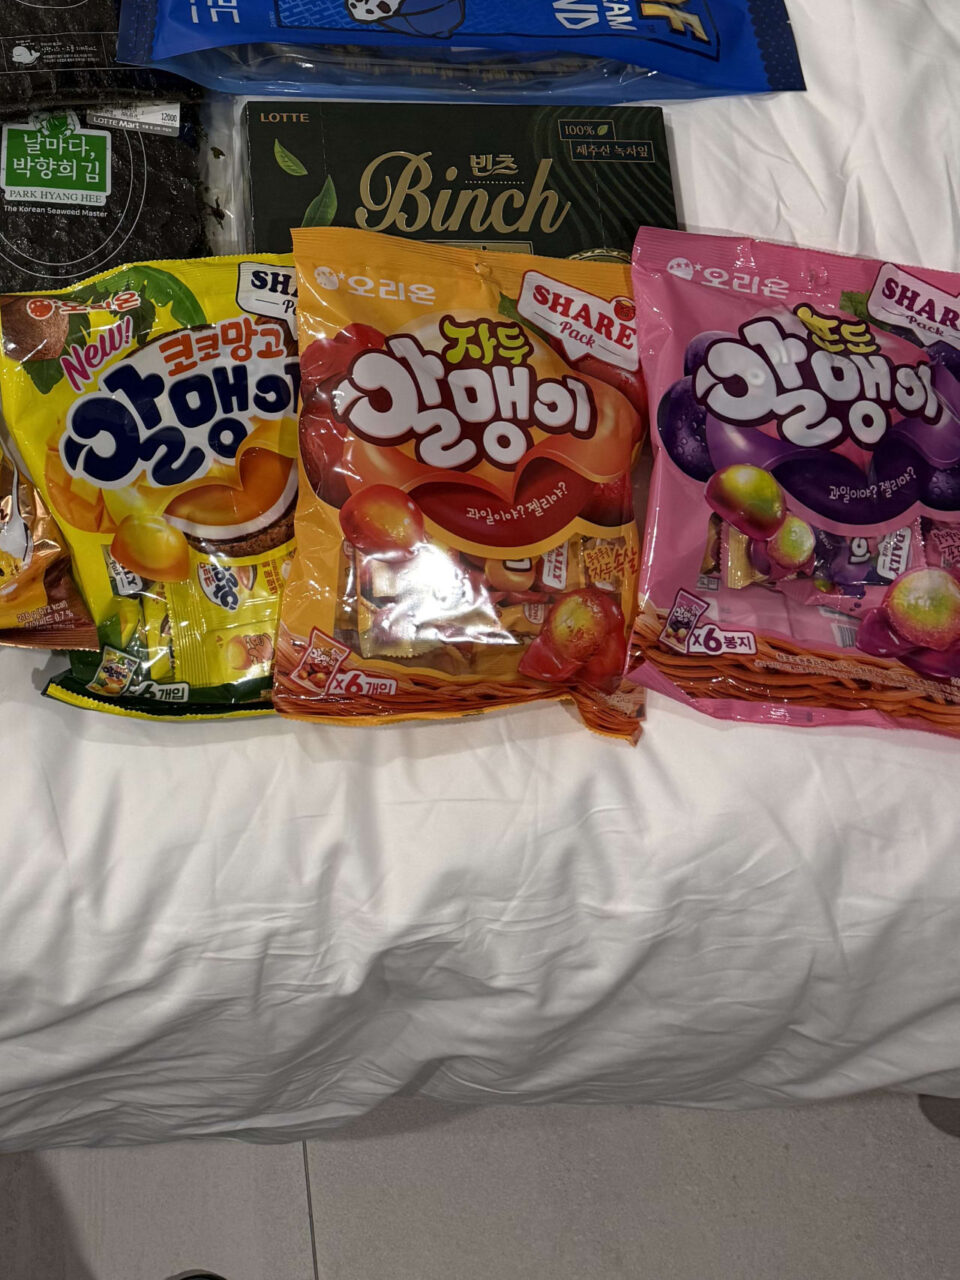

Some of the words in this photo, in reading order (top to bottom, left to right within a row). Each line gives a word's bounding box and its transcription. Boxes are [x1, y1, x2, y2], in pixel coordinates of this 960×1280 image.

[93, 116, 118, 127] LOTTE
[119, 119, 140, 129] Mart
[260, 113, 309, 123] LOTTE
[563, 124, 595, 136] 100%
[23, 133, 96, 159] 날마다,
[575, 145, 611, 157] 제주산
[12, 155, 77, 180] 박향희
[81, 160, 101, 183] 김
[9, 190, 38, 200] PARK
[40, 190, 79, 202] HYANG
[81, 193, 103, 204] HEE
[354, 151, 572, 234] Binch
[4, 205, 17, 213] The
[19, 206, 46, 215] Korean
[47, 207, 81, 217] Seaweed
[82, 209, 108, 218] Master
[348, 275, 436, 305] 오리온
[701, 267, 790, 299] 오리온
[532, 284, 637, 351] SHARE
[881, 278, 960, 328] SHAR
[158, 317, 286, 377] 코코망고
[443, 320, 530, 365] 자두
[559, 320, 596, 350] Pack
[61, 316, 134, 392] New!
